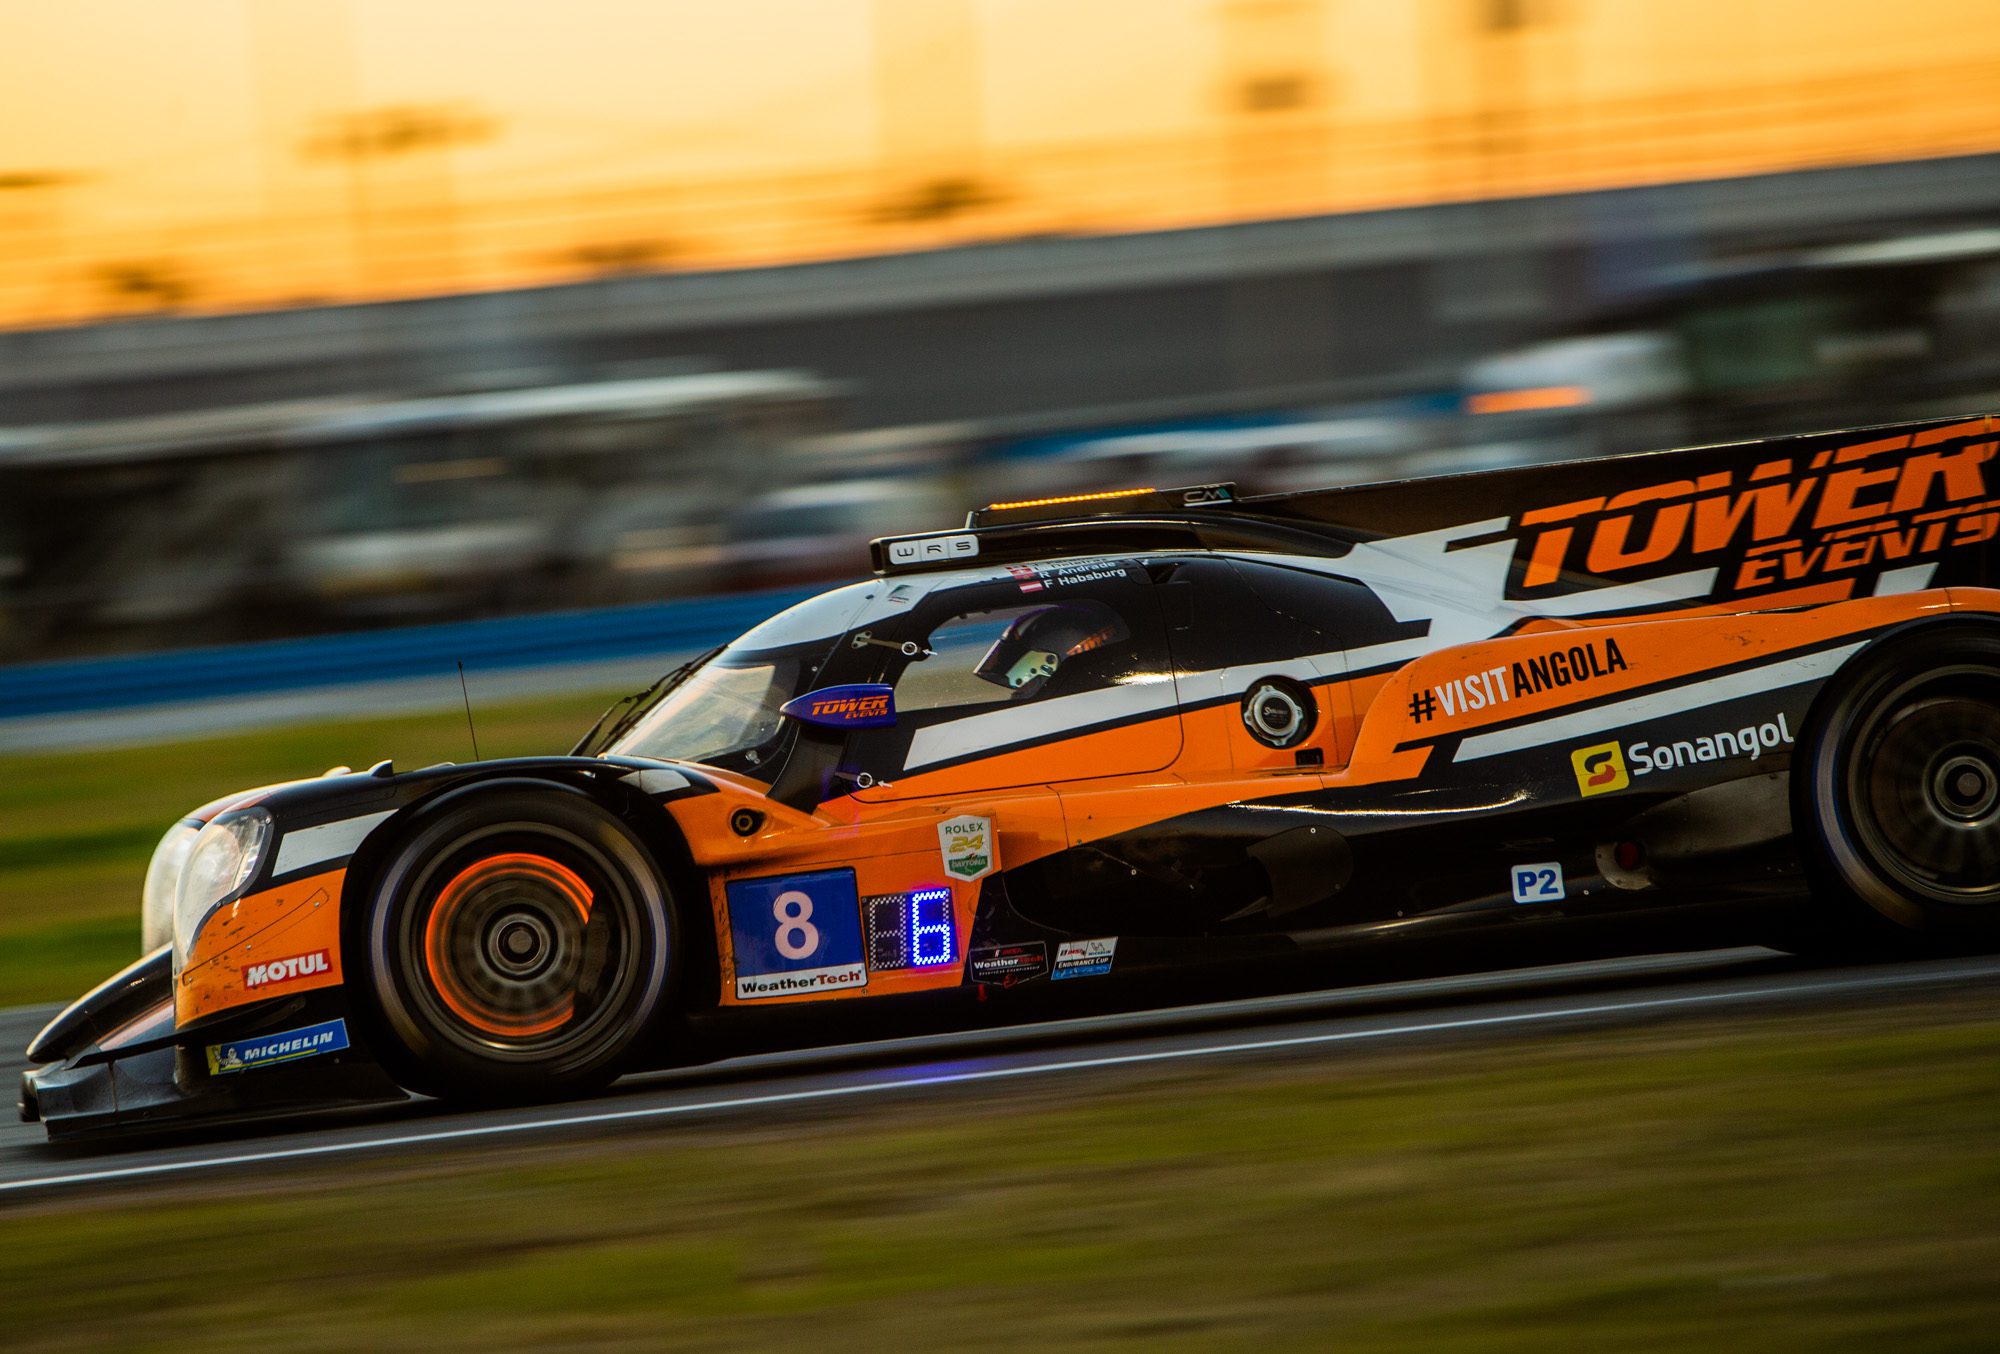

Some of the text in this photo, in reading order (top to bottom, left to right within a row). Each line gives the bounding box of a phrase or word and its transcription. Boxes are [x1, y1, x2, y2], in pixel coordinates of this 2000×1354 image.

[1520, 416, 2000, 588] TOWER
[1734, 500, 2000, 590] EVENTS
[1039, 571, 1051, 579] R
[1058, 561, 1117, 576] Andrade
[1043, 568, 1128, 589] F Habsburg
[1409, 638, 1627, 724] #VISITANGOLA
[812, 695, 889, 716] TOWER
[845, 707, 889, 719] EVENTS
[1628, 713, 1794, 777] Sonangol
[945, 822, 983, 835] ROLEX
[949, 834, 983, 853] 24
[951, 858, 986, 868] DAYTONA
[1517, 869, 1559, 896] P2
[773, 891, 819, 960] 8
[912, 891, 950, 965] 6
[247, 953, 329, 987] MOTUL
[974, 954, 1045, 970] WeatherTech
[1058, 957, 1109, 969] ENDURANCE CUP
[742, 970, 861, 993] WeatherTech
[244, 1031, 334, 1060] MICHELIN
